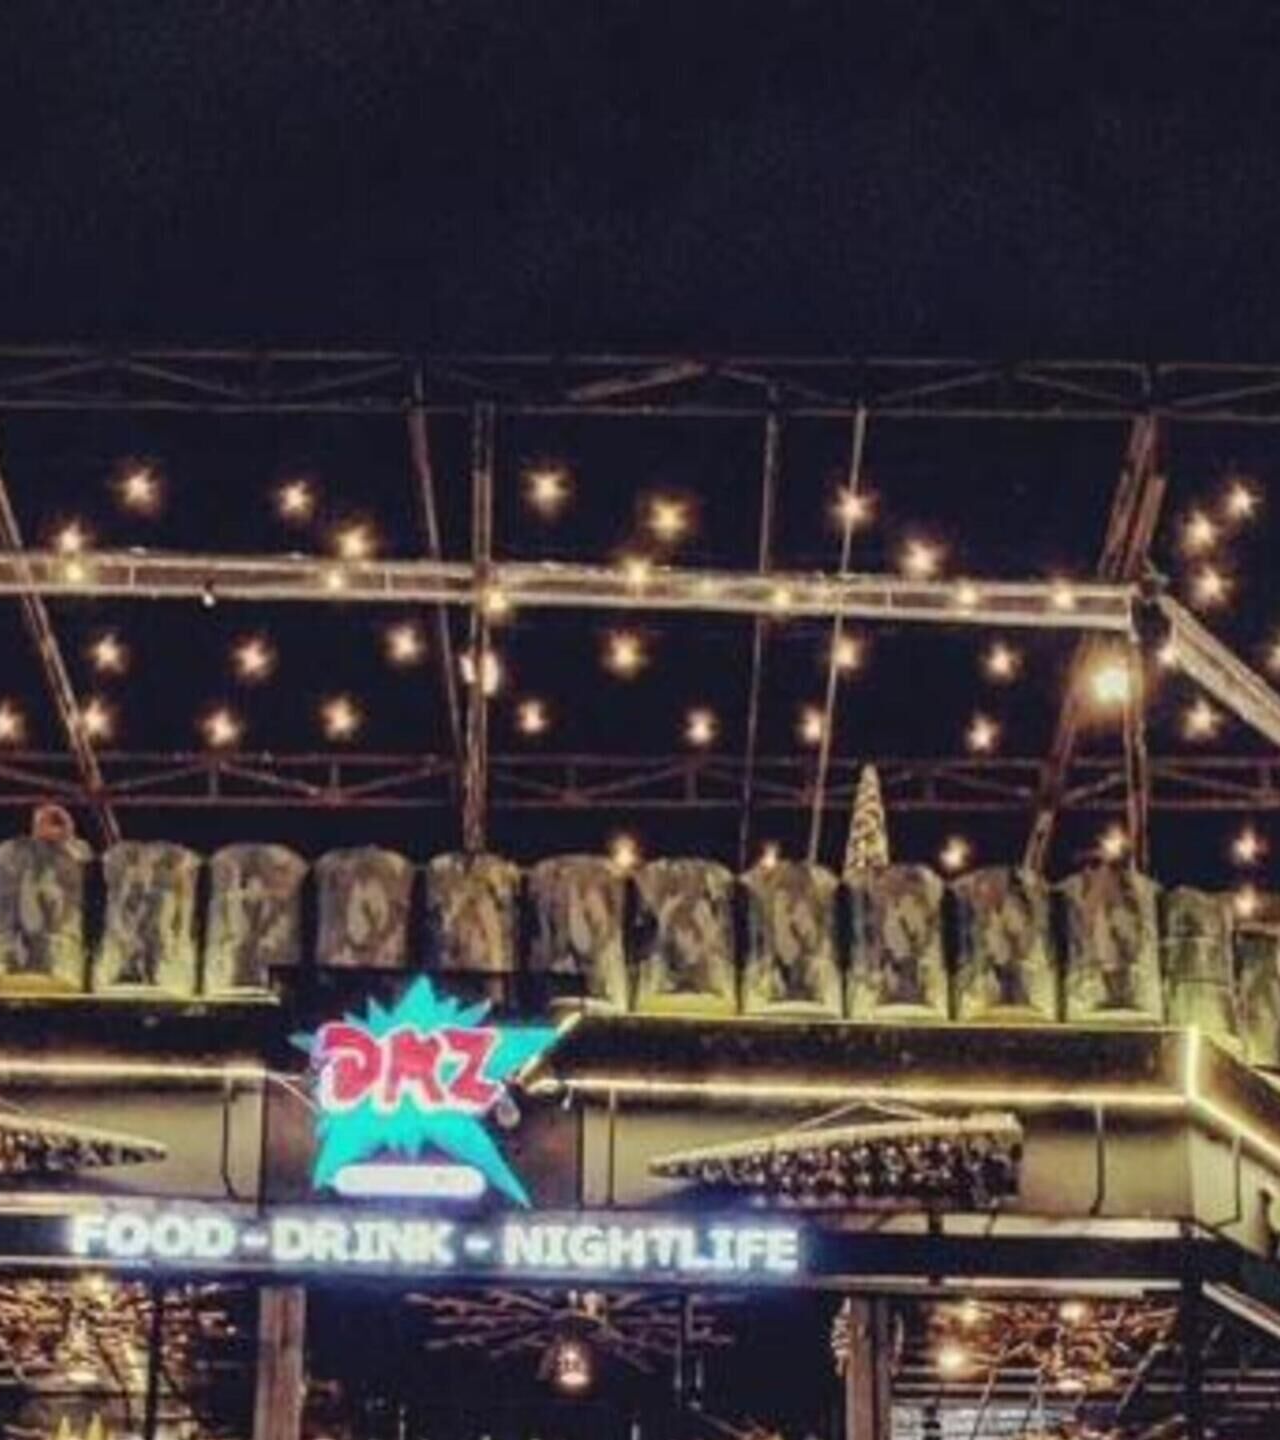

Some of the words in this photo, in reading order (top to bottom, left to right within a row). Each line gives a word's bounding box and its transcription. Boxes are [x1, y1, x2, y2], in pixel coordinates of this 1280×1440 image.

[310, 1022, 503, 1114] DMZ
[71, 1214, 237, 1260] FOOD
[271, 1218, 456, 1266] DRINK
[503, 1223, 800, 1271] NIGHTLIFE
